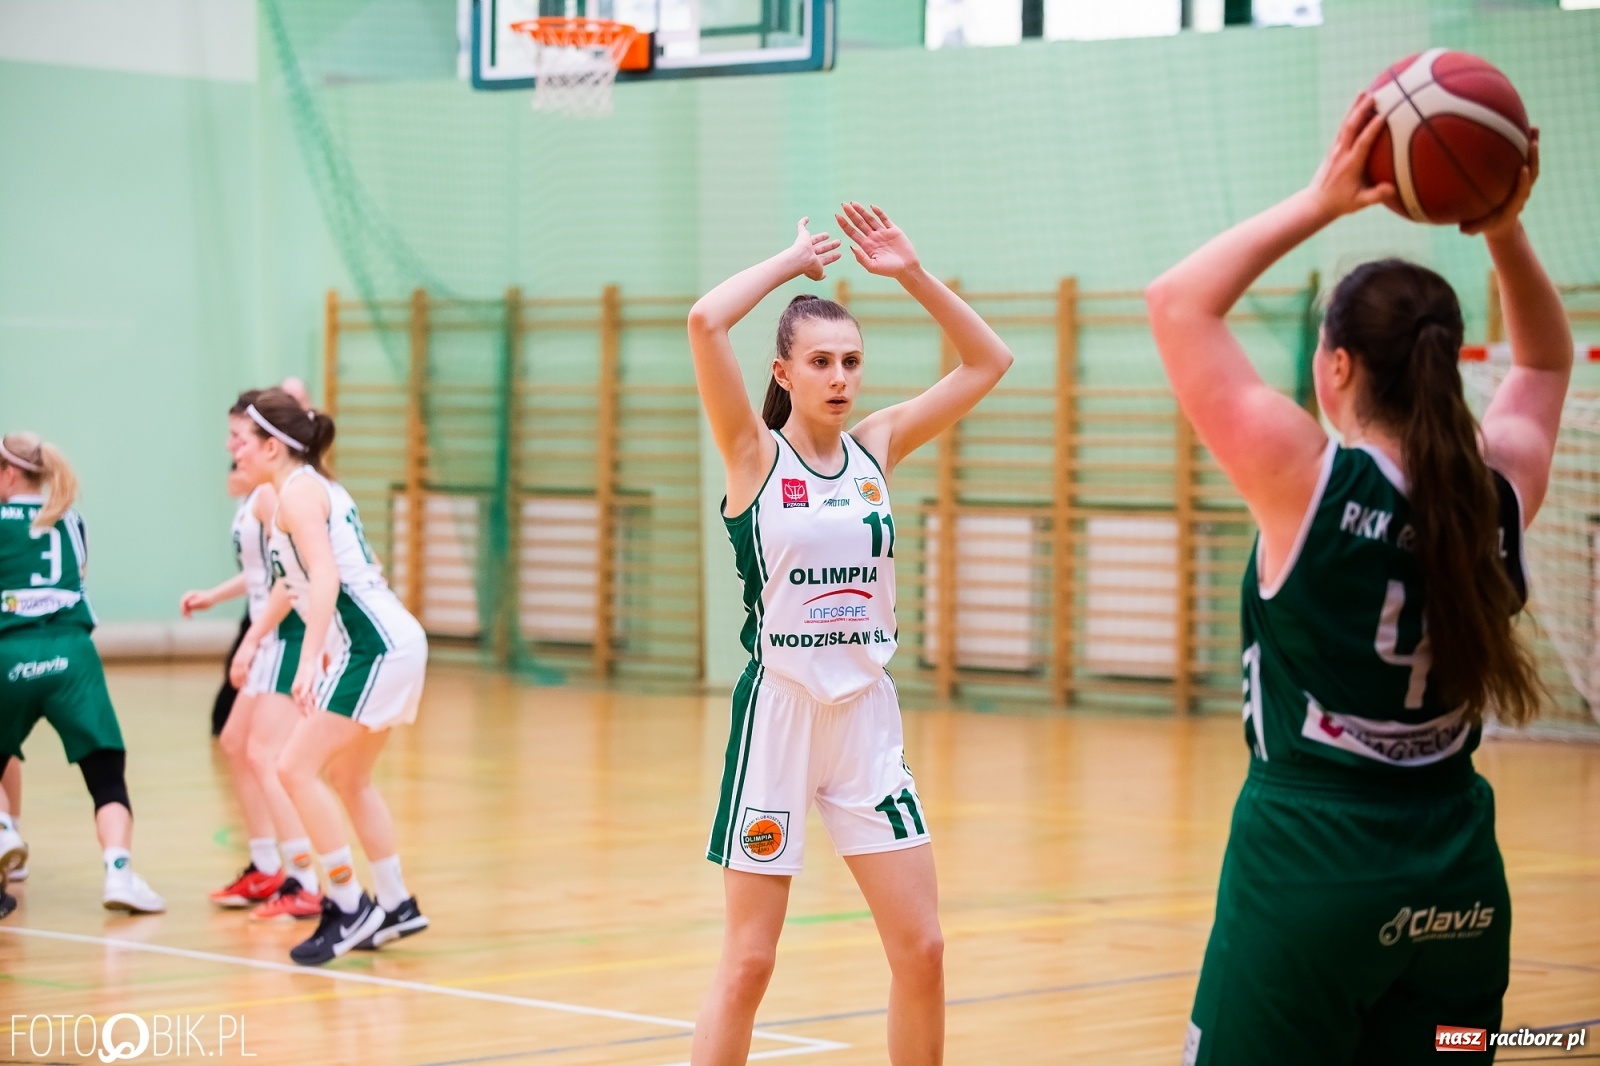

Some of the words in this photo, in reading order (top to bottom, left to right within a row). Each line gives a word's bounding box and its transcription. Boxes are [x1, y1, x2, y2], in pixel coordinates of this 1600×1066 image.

[862, 511, 895, 559] 11
[1339, 500, 1393, 543] RKK
[29, 525, 62, 587] 3
[789, 566, 877, 585] OLIMPIA
[809, 605, 867, 619] INFOSAFE
[769, 629, 871, 648] WODZISŁAW
[874, 627, 891, 643] ŚL.
[1374, 578, 1433, 710] 4
[874, 787, 925, 840] 11
[744, 833, 773, 843] OLIMPIA
[1408, 900, 1496, 937] Clavis
